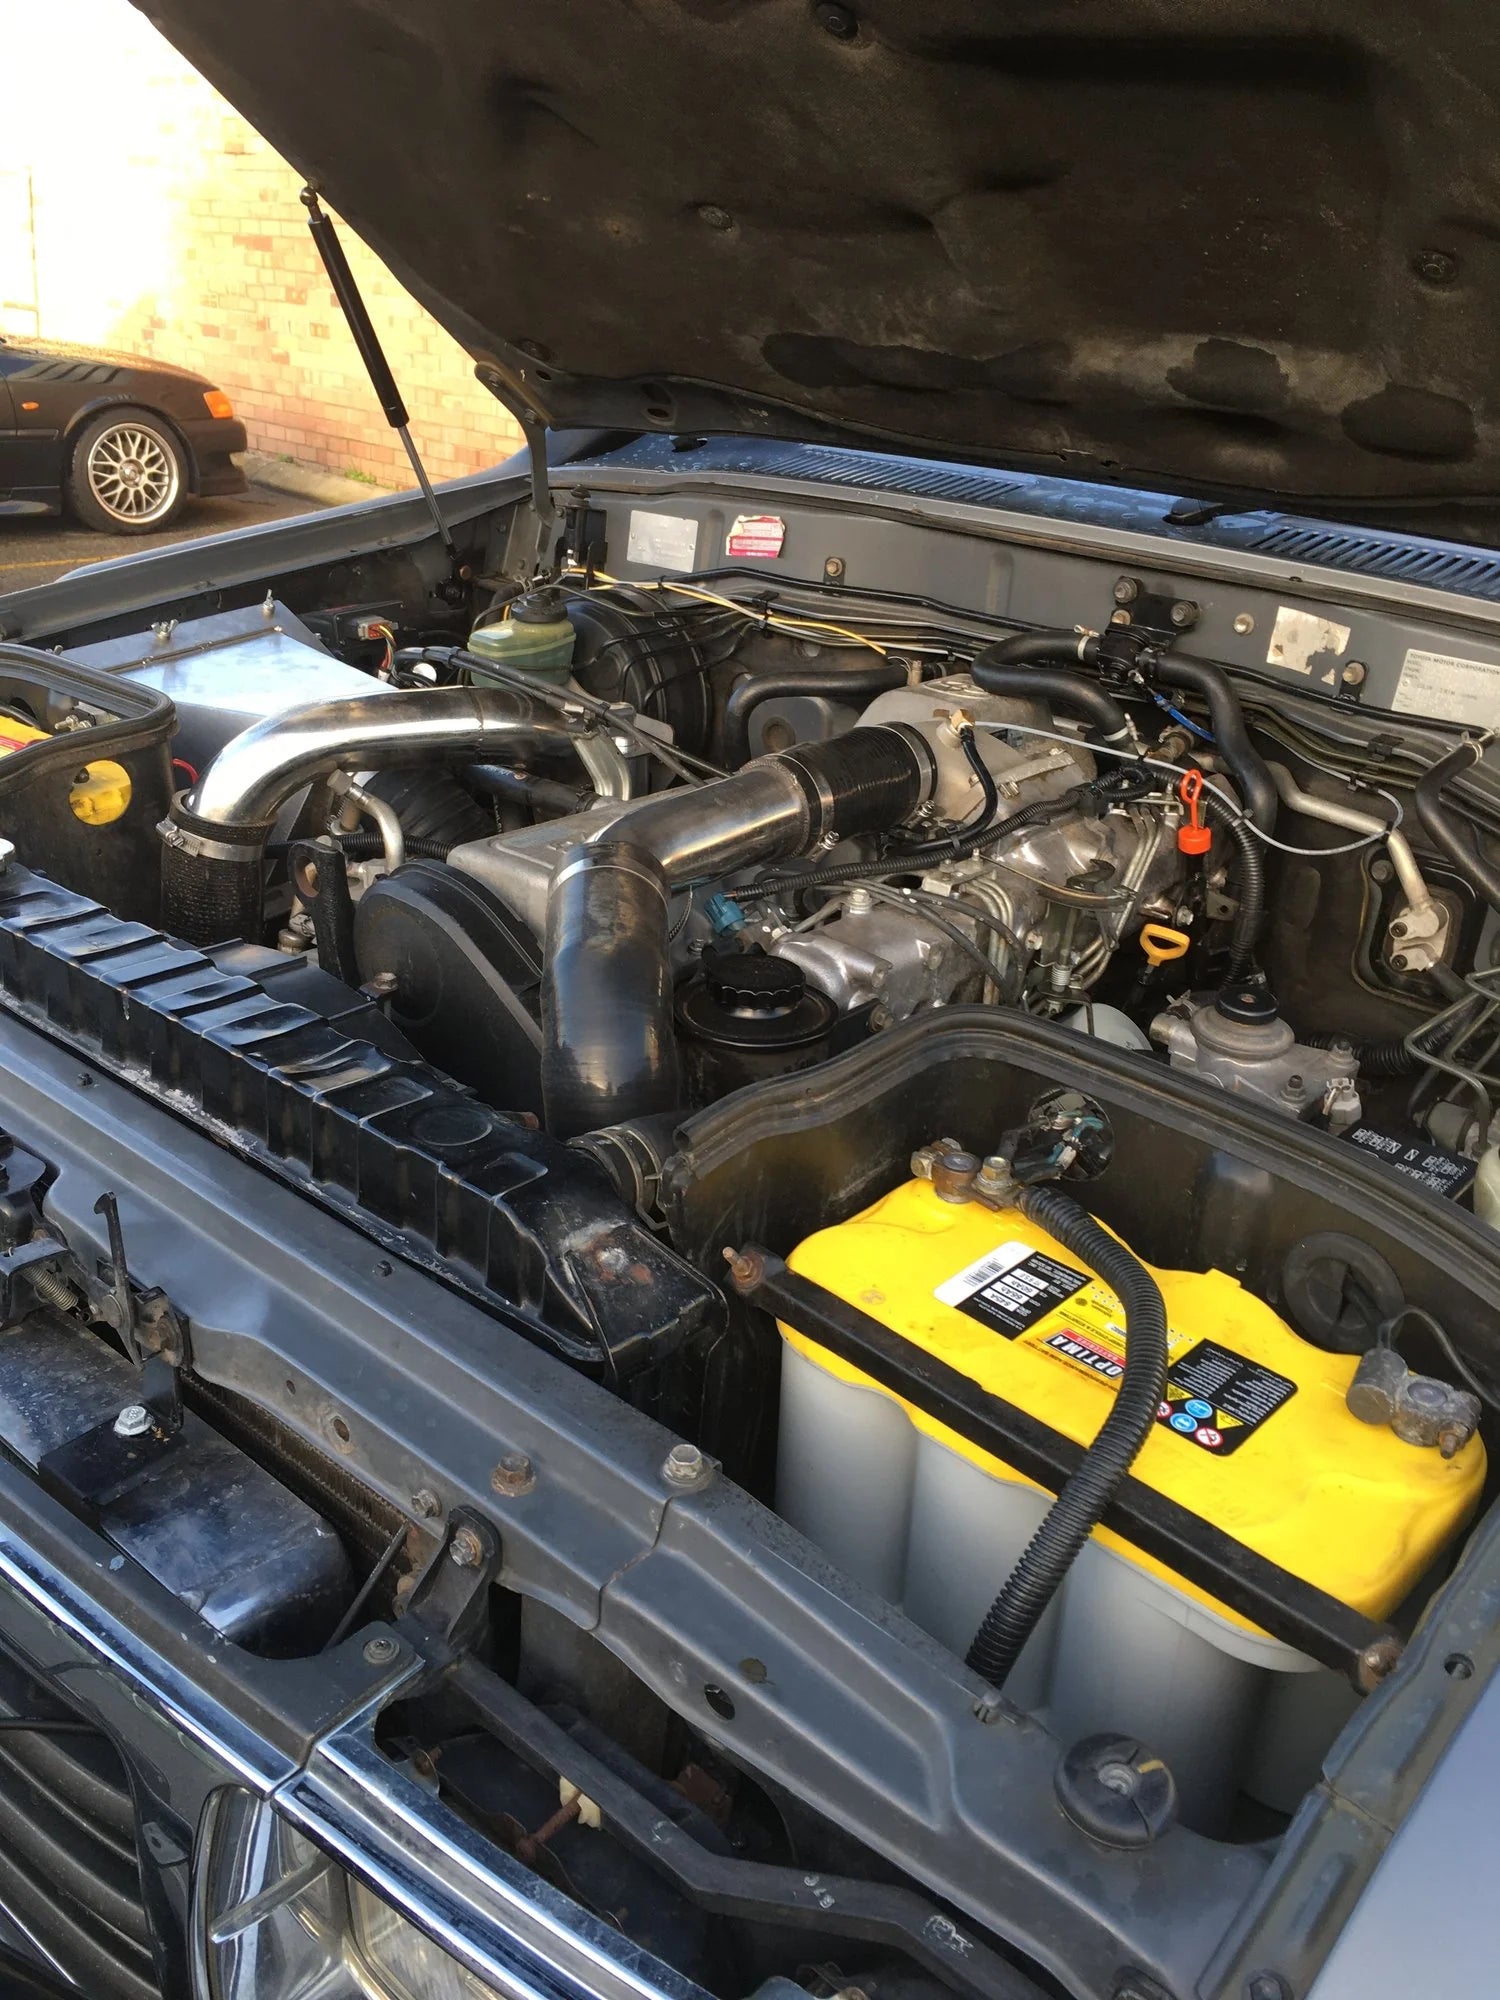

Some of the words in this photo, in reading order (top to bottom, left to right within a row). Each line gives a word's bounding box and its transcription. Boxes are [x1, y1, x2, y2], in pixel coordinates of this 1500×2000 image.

[1410, 653, 1431, 661] TOYOTA
[1433, 658, 1454, 666] MOTOR
[1456, 663, 1500, 675] CORPORATION
[1050, 1335, 1123, 1376] OPTIMA
[1076, 1336, 1119, 1361] BATTERIES
